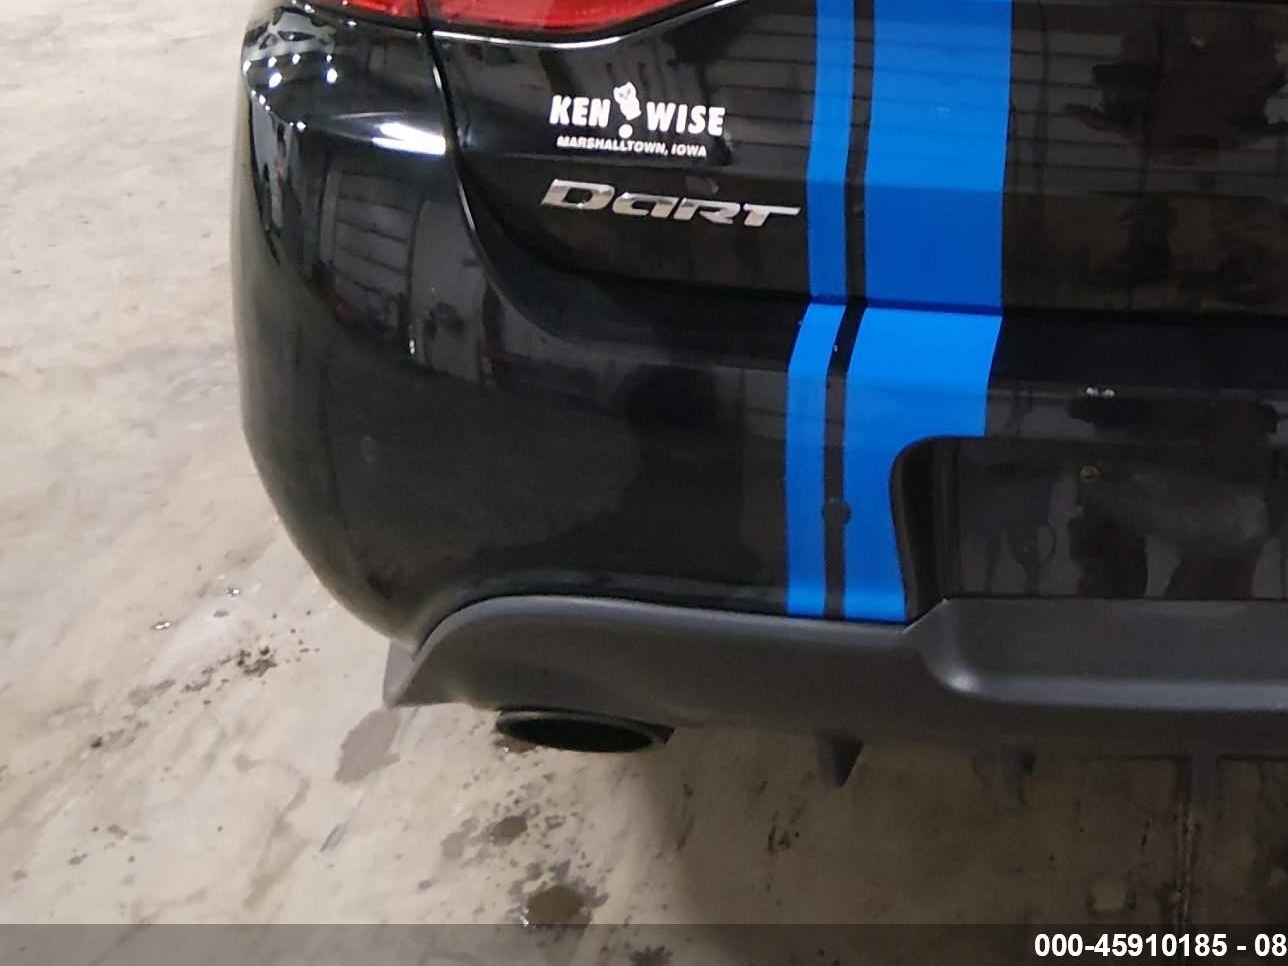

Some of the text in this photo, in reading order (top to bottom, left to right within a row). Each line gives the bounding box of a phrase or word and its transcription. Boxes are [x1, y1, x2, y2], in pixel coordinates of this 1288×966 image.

[549, 95, 726, 136] KEN WISE
[556, 135, 707, 157] MARSHALLTOWN, IOWA
